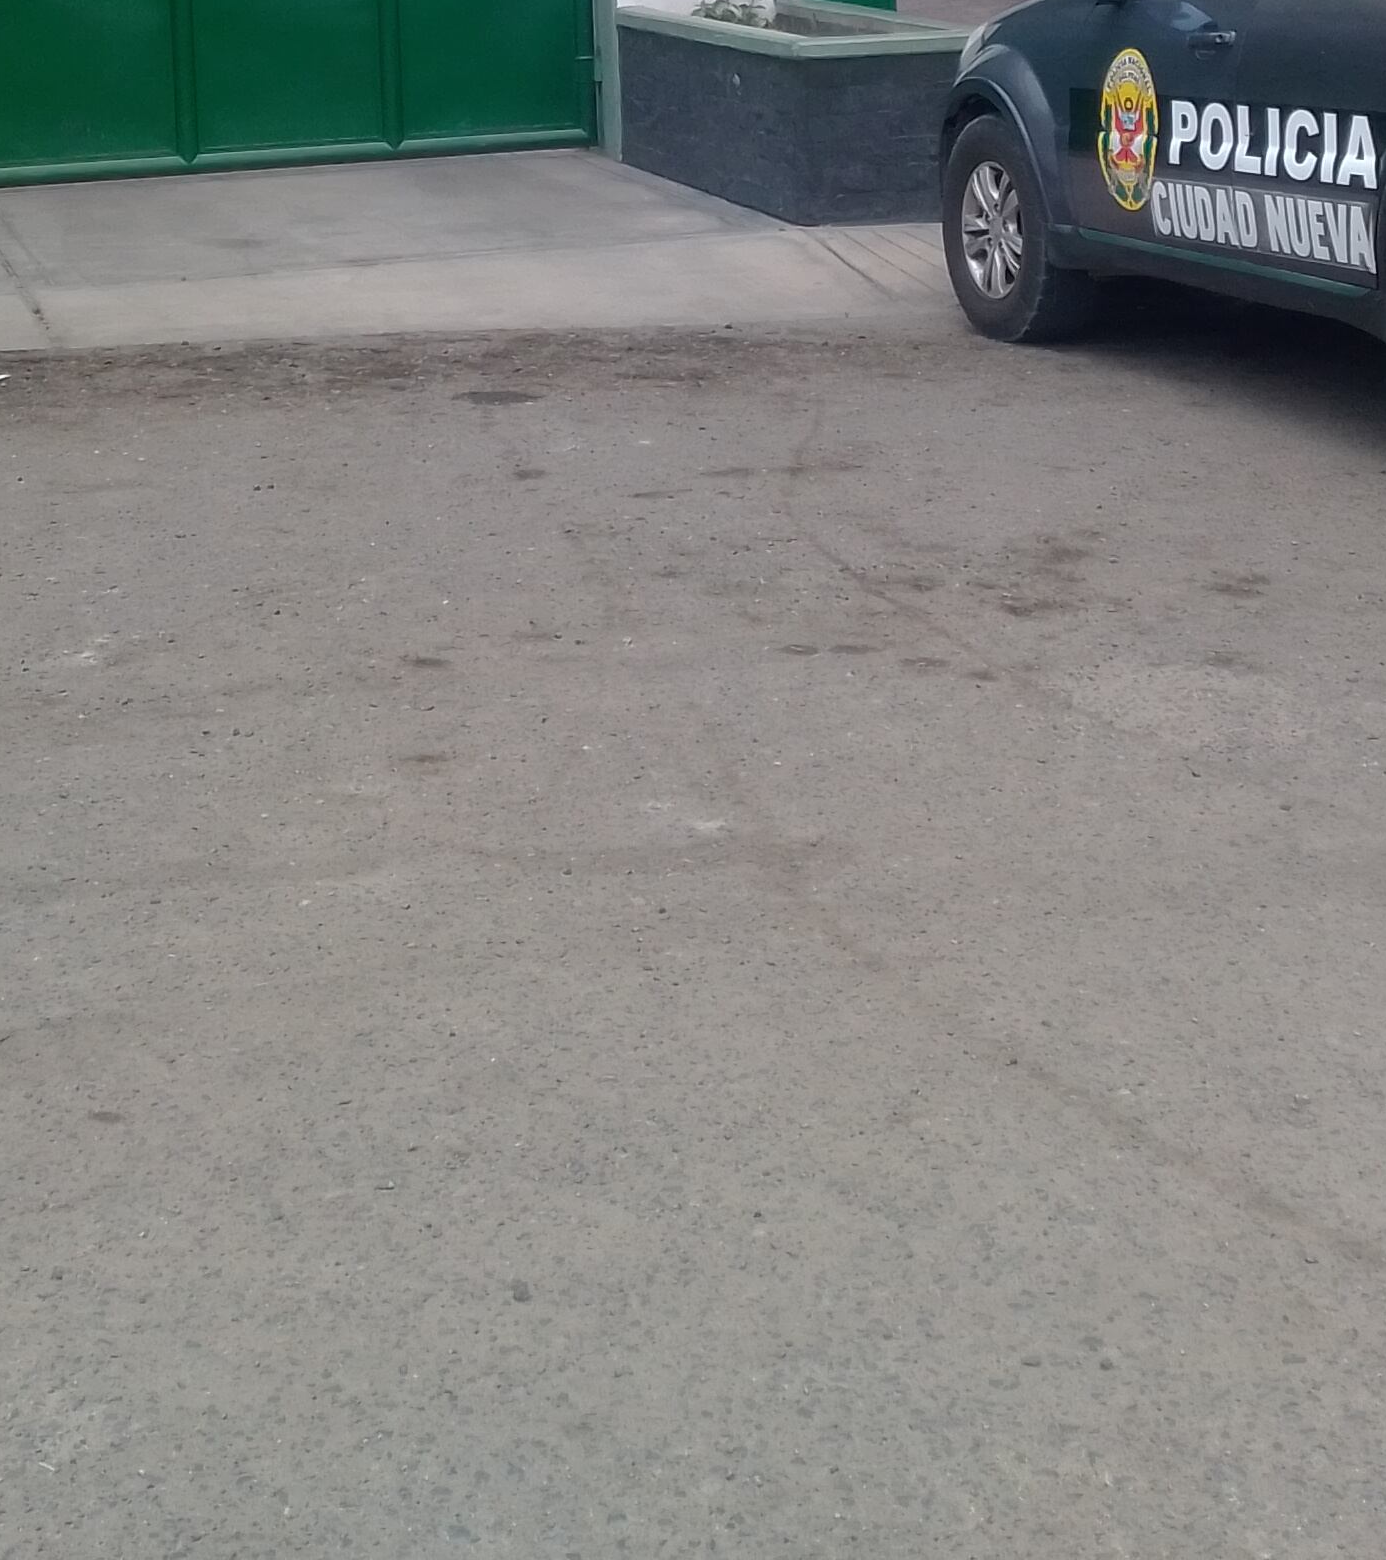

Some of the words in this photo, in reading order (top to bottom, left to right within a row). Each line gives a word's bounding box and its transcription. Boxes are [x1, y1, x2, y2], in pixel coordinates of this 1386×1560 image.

[1168, 99, 1378, 190] POLICIA
[1151, 181, 1259, 249] CIUDAD
[1264, 193, 1377, 274] NUEVA
